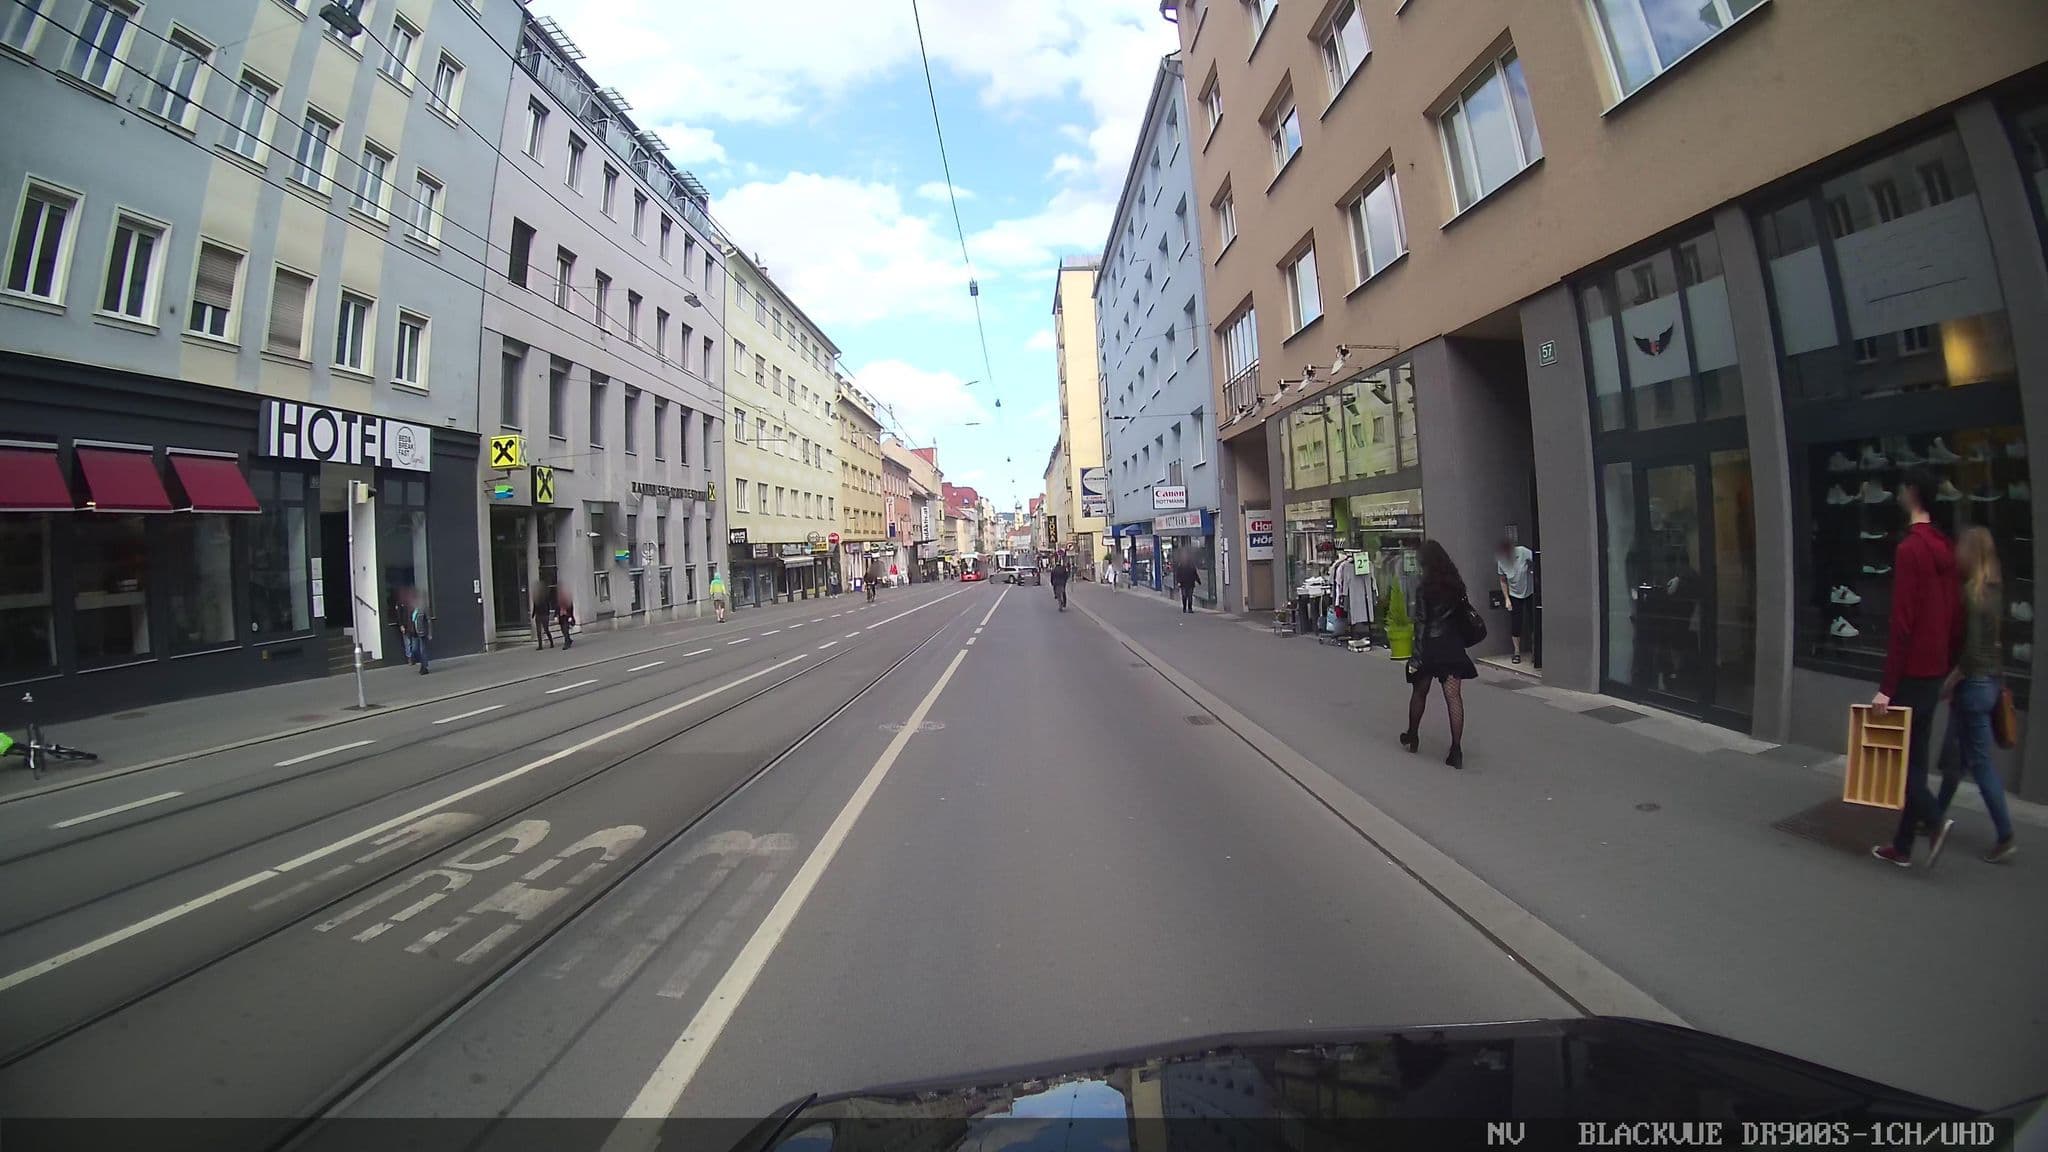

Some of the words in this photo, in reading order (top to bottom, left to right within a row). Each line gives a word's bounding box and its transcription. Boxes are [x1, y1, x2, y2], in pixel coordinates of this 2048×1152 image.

[1542, 343, 1553, 358] 57
[279, 401, 392, 468] HOTEL
[1155, 490, 1184, 498] Canon
